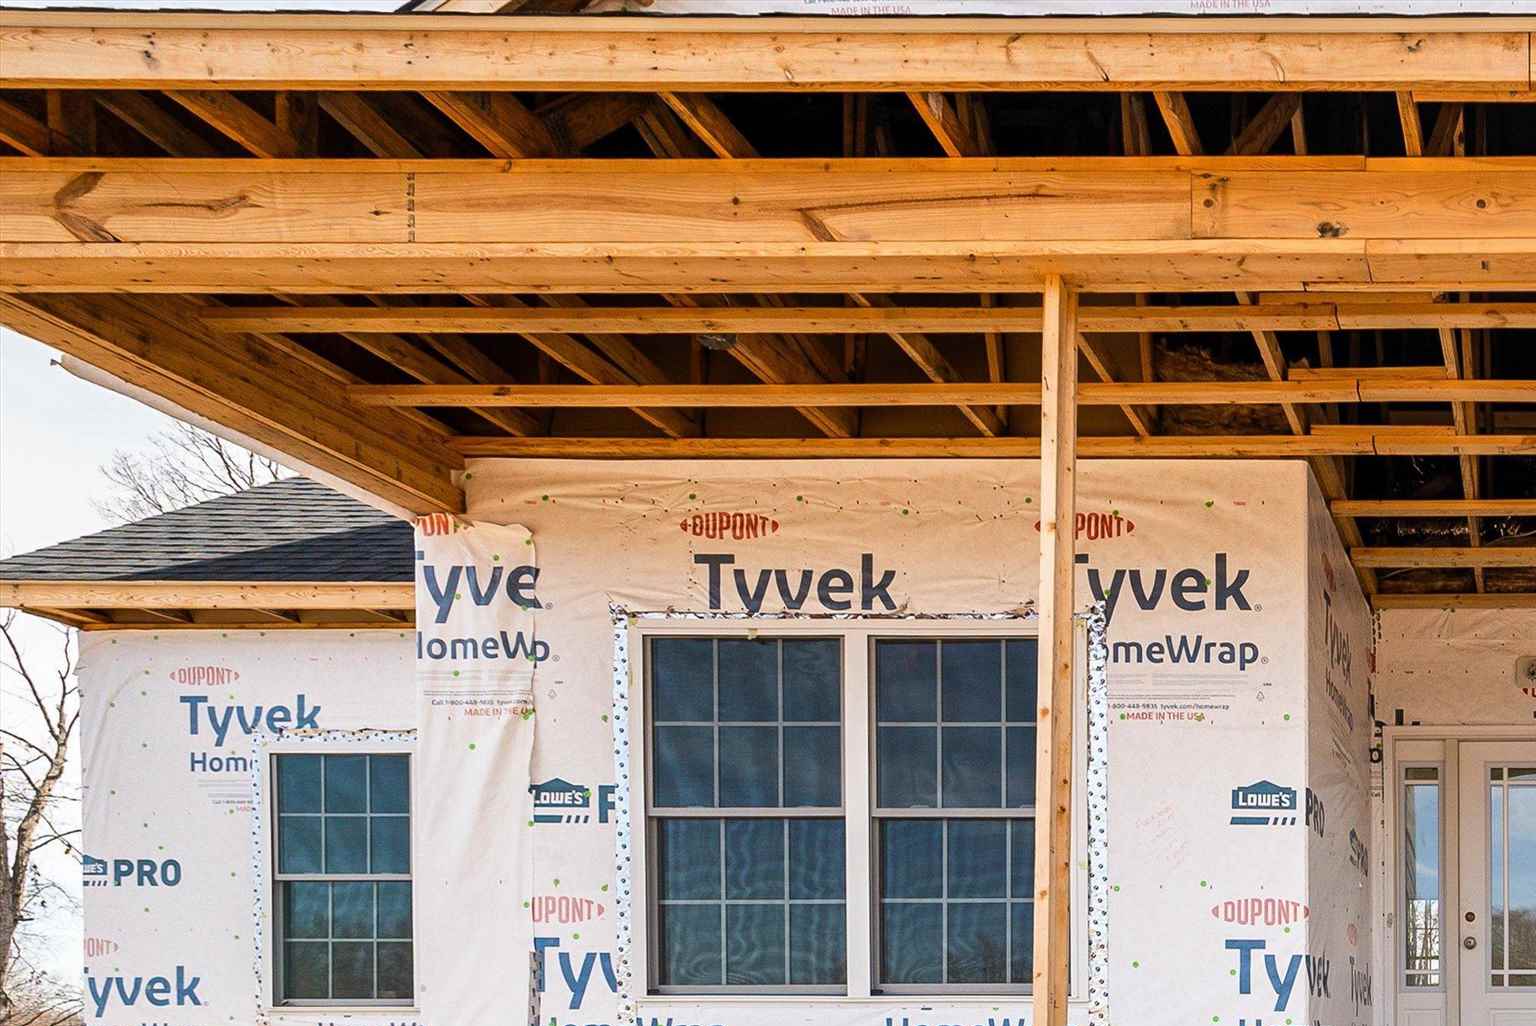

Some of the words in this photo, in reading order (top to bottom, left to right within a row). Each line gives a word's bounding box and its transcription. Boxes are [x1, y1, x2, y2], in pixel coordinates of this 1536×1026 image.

[692, 512, 769, 541] DUPONT
[1074, 512, 1125, 541] PONT
[693, 553, 898, 614] Tyvek
[1074, 553, 1253, 626] yvek
[1105, 634, 1260, 672] meWrap
[178, 666, 234, 686] DUPONT
[180, 693, 321, 747] Tyvek
[1126, 711, 1153, 720] MADE
[1168, 711, 1185, 720] THE
[1187, 711, 1206, 720] USA
[1237, 791, 1292, 807] LOWE'S
[113, 858, 182, 887] PRO
[1223, 897, 1301, 927] DUPONT
[84, 966, 202, 1018] yvek
